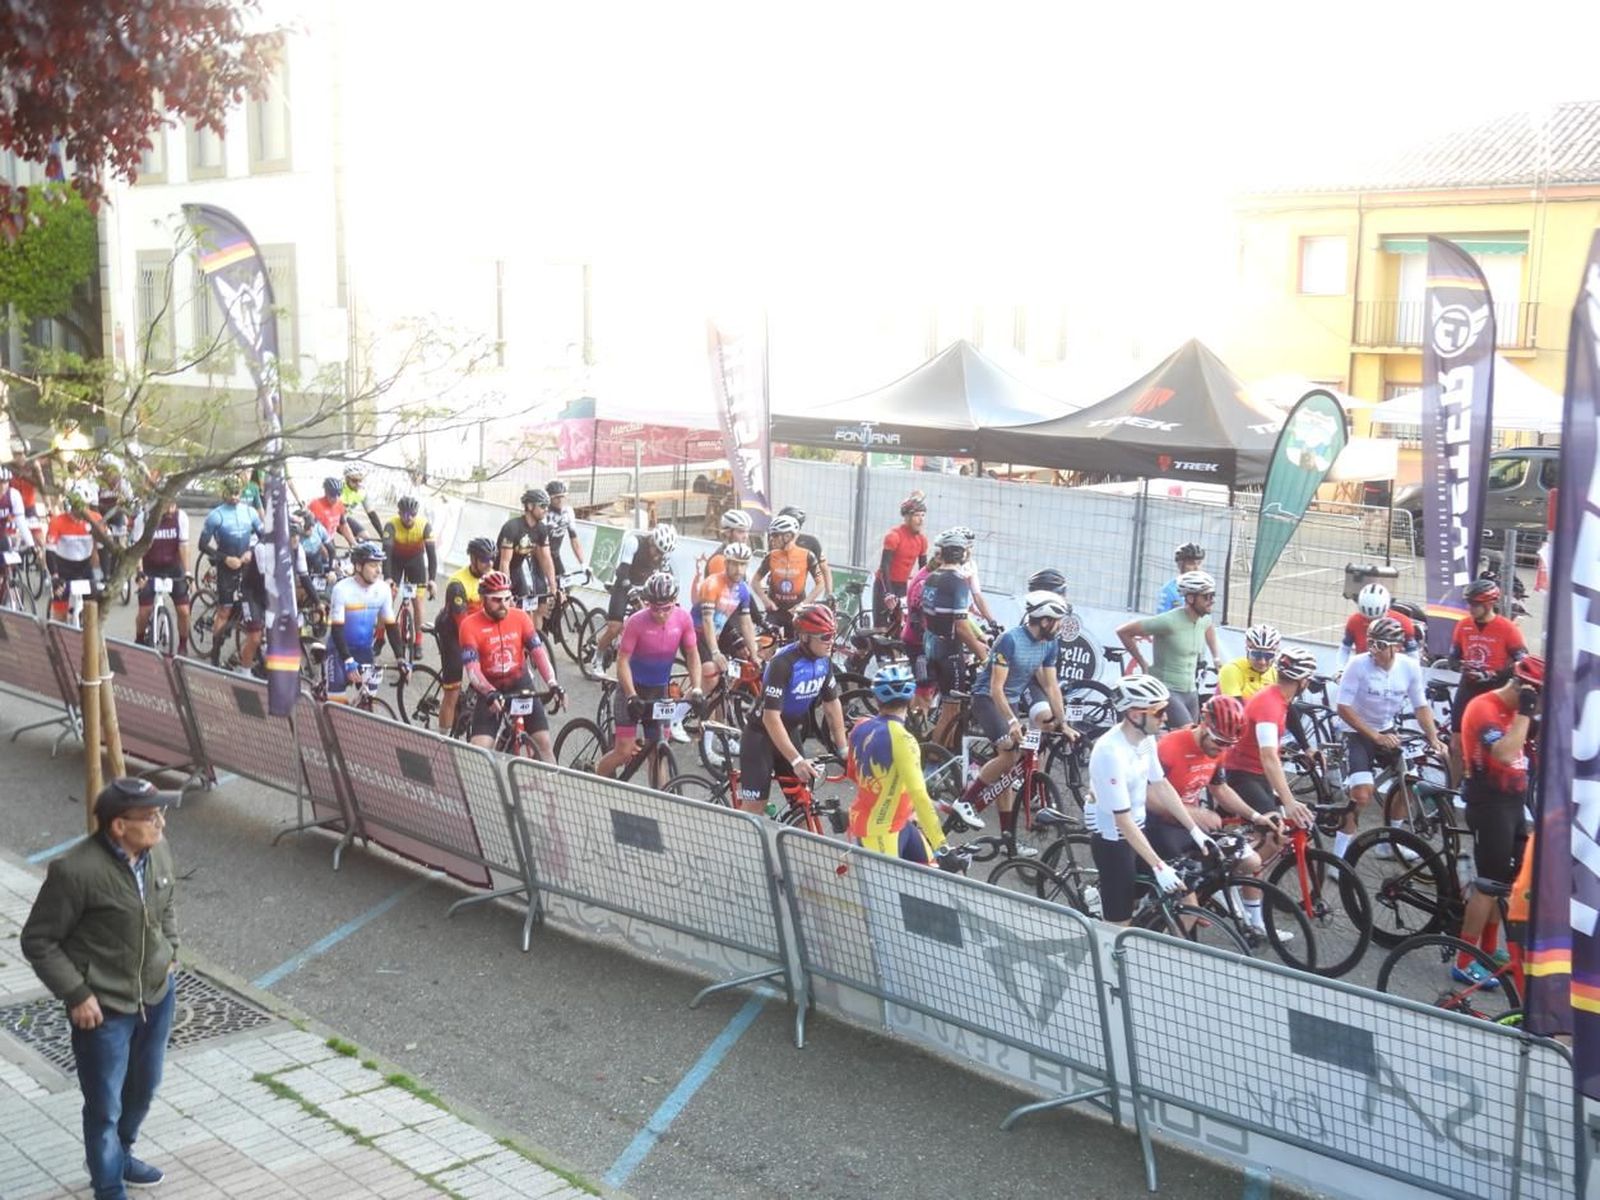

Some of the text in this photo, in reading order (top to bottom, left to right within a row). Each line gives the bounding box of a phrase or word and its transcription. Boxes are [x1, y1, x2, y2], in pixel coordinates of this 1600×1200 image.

[1173, 460, 1219, 472] TREK
[1060, 646, 1090, 665] rella
[1060, 661, 1085, 680] icia
[791, 675, 826, 695] ADN
